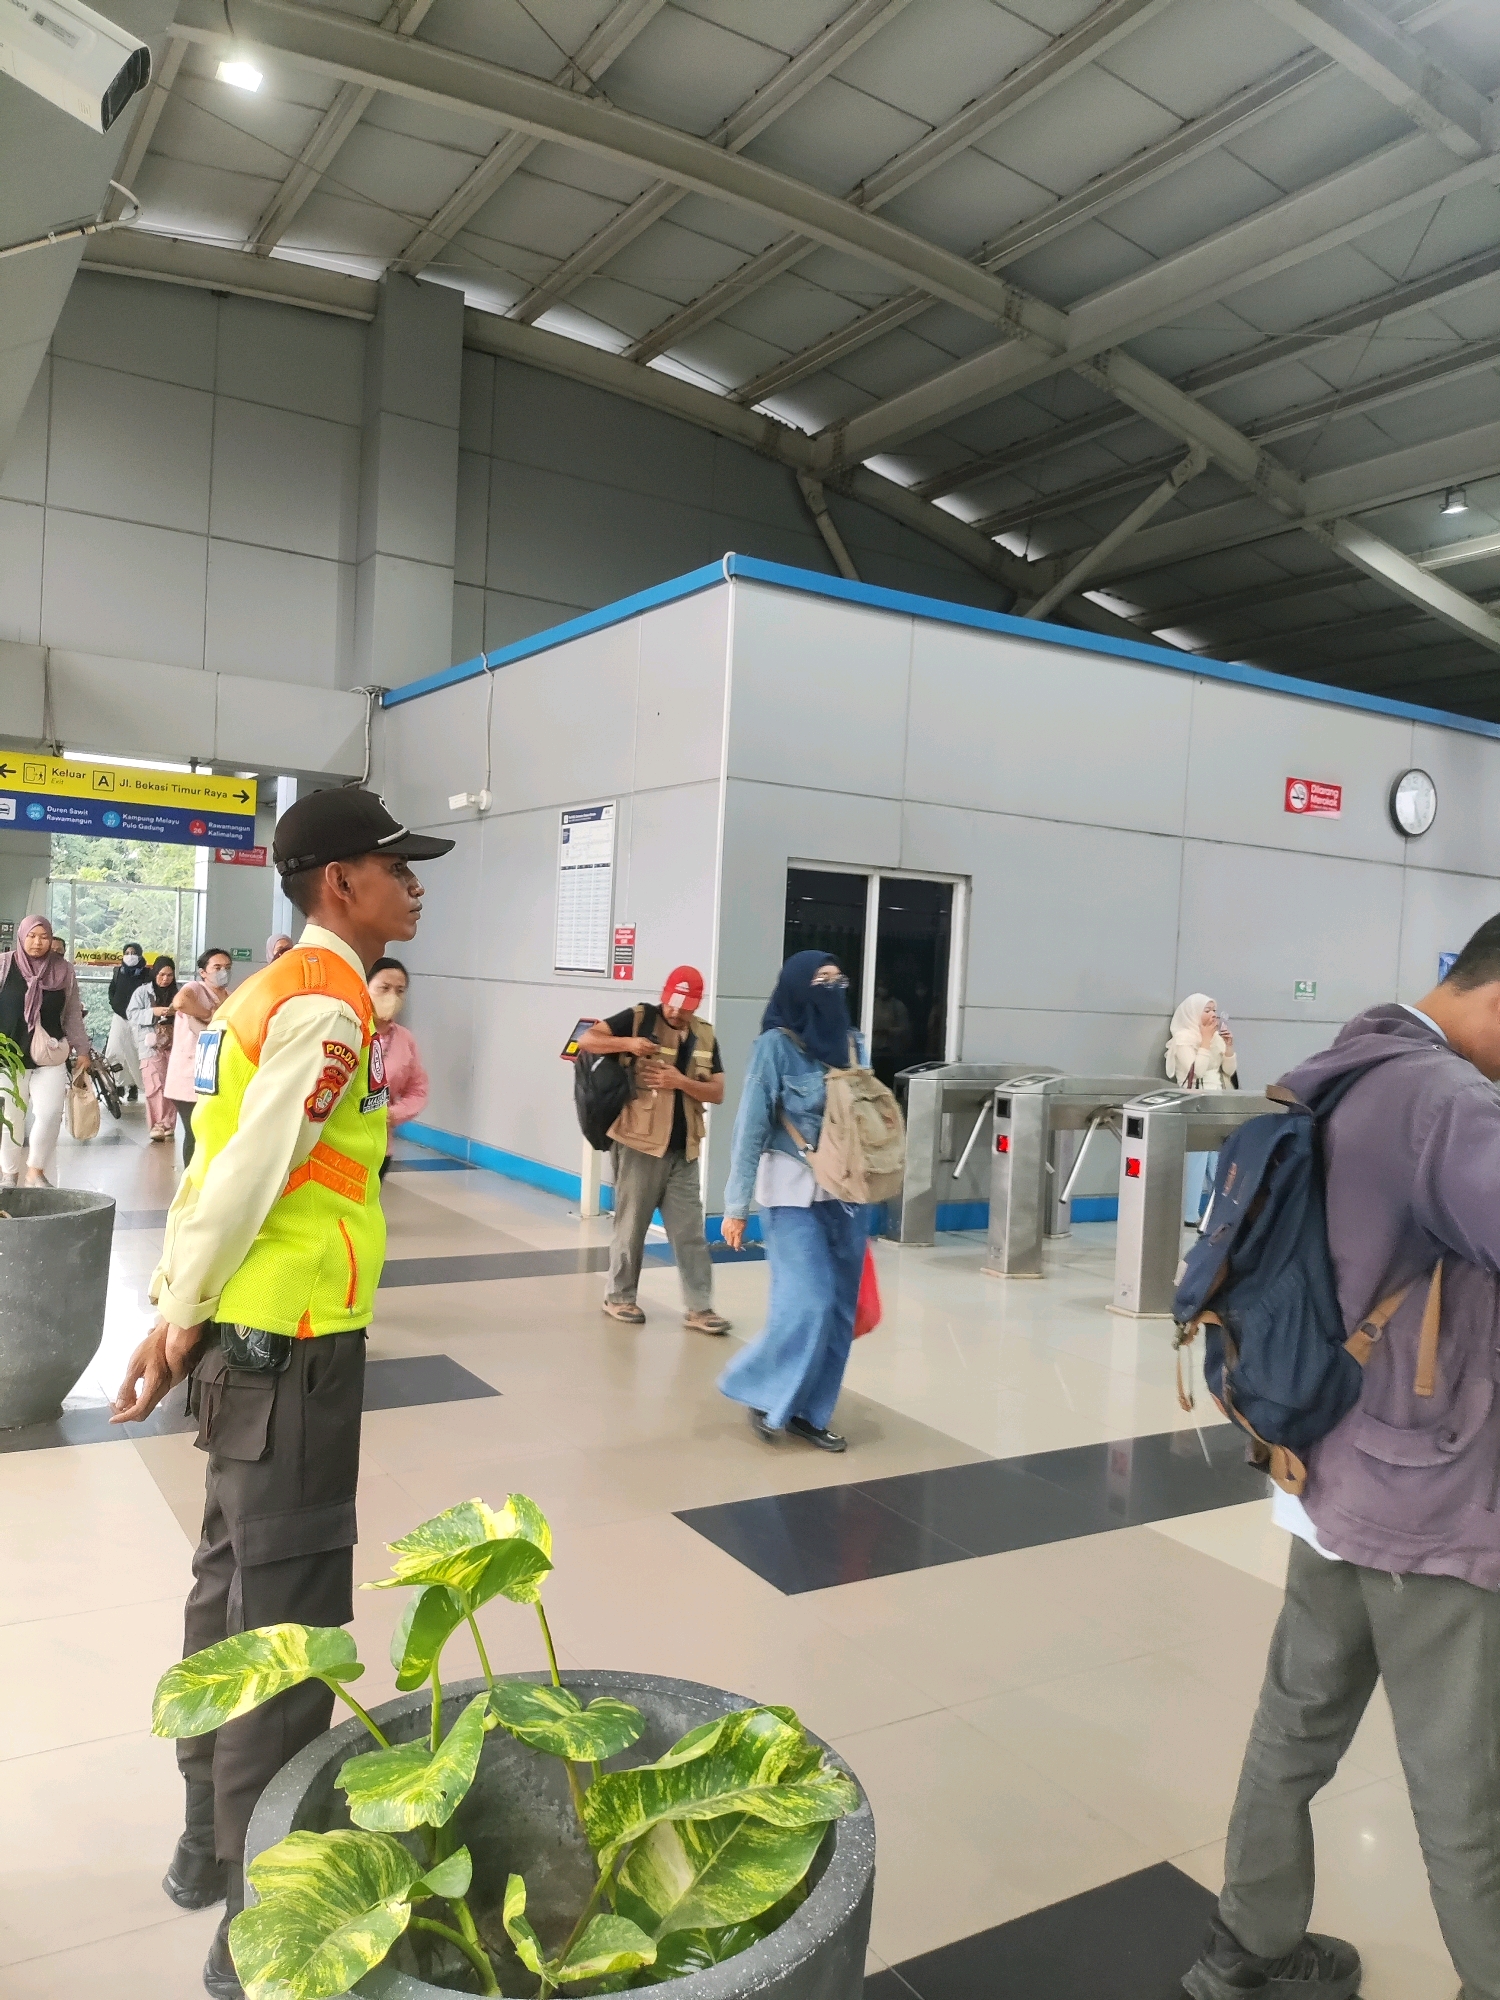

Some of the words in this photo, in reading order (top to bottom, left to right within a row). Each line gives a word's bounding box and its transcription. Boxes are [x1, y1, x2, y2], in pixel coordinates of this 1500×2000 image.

[52, 768, 86, 779] Keluar
[98, 776, 109, 787] A
[120, 779, 132, 788] Jl.
[136, 780, 168, 792] Bekasi
[172, 784, 202, 796] Timur
[204, 788, 228, 800] Raya
[47, 806, 68, 814] Duren
[46, 814, 92, 824] Rawamangun
[122, 814, 154, 823] Kampung
[138, 824, 164, 832] Gadung
[208, 822, 250, 831] Rawamangun
[208, 831, 243, 840] Kalimalang
[75, 951, 102, 961] Awas
[104, 952, 122, 962] Kac
[326, 1044, 356, 1068] POLDA
